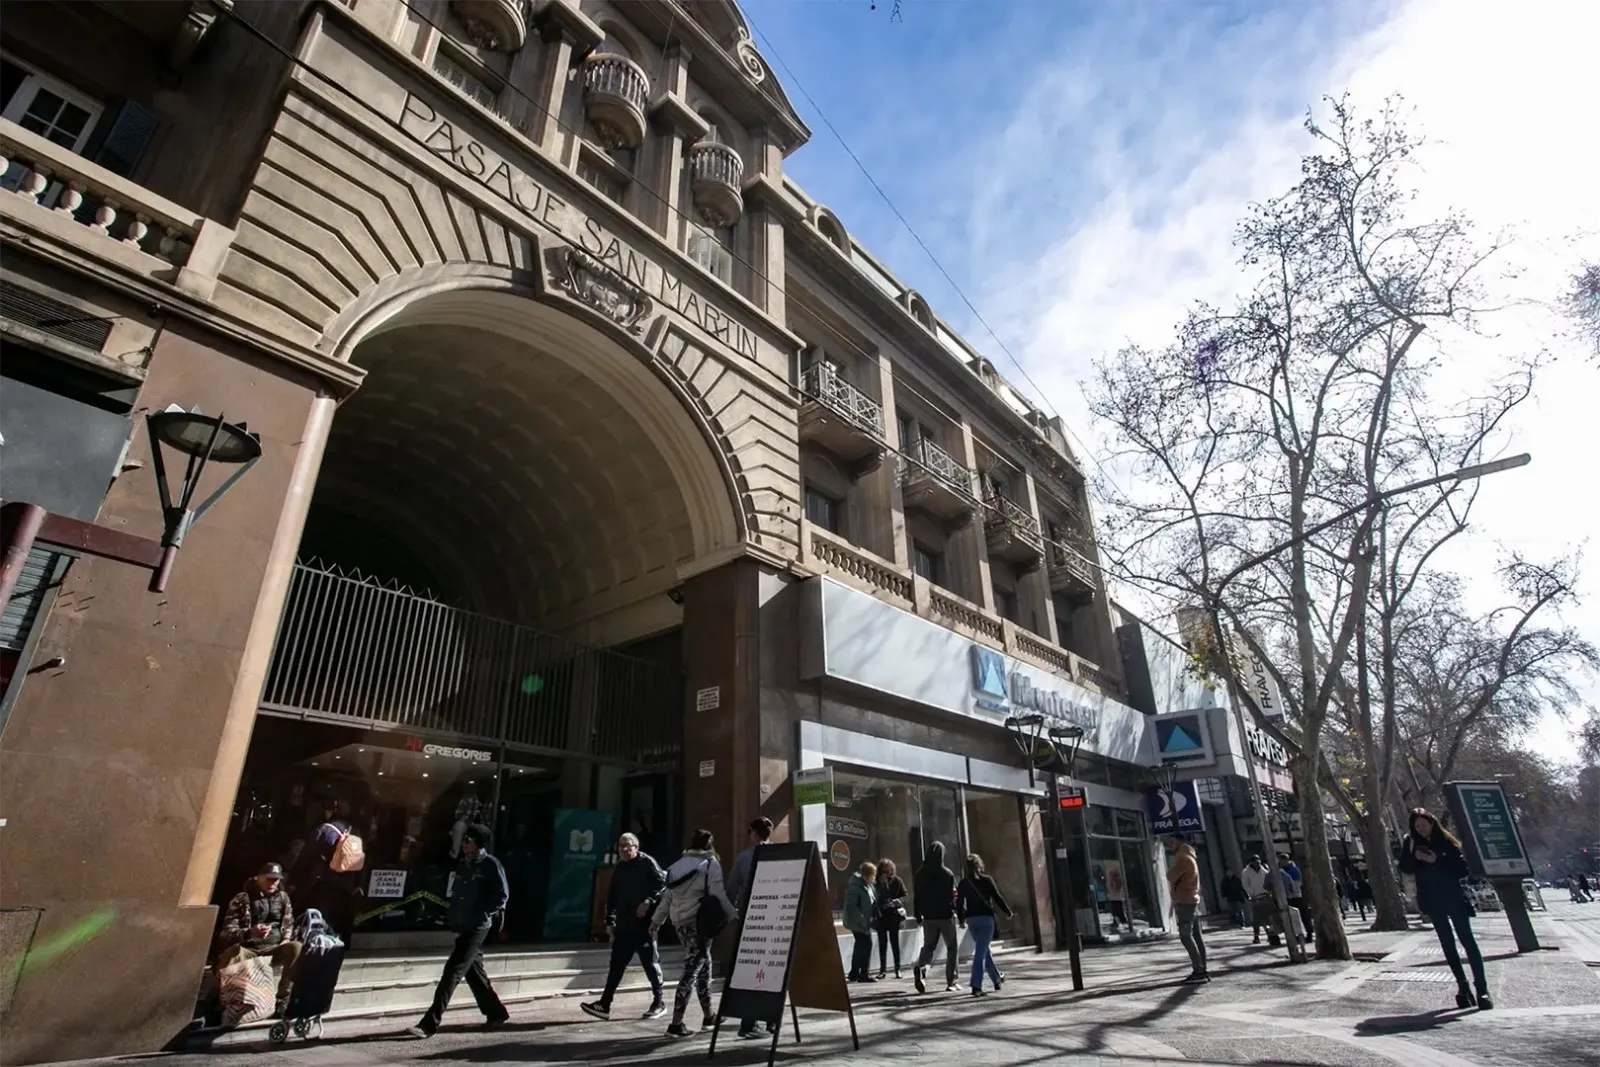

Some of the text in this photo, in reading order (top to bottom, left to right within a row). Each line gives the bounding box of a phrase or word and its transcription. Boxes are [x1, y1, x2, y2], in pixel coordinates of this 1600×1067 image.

[398, 91, 758, 360] PASAJE SAN MARTIN
[423, 744, 492, 761] GREGORIS
